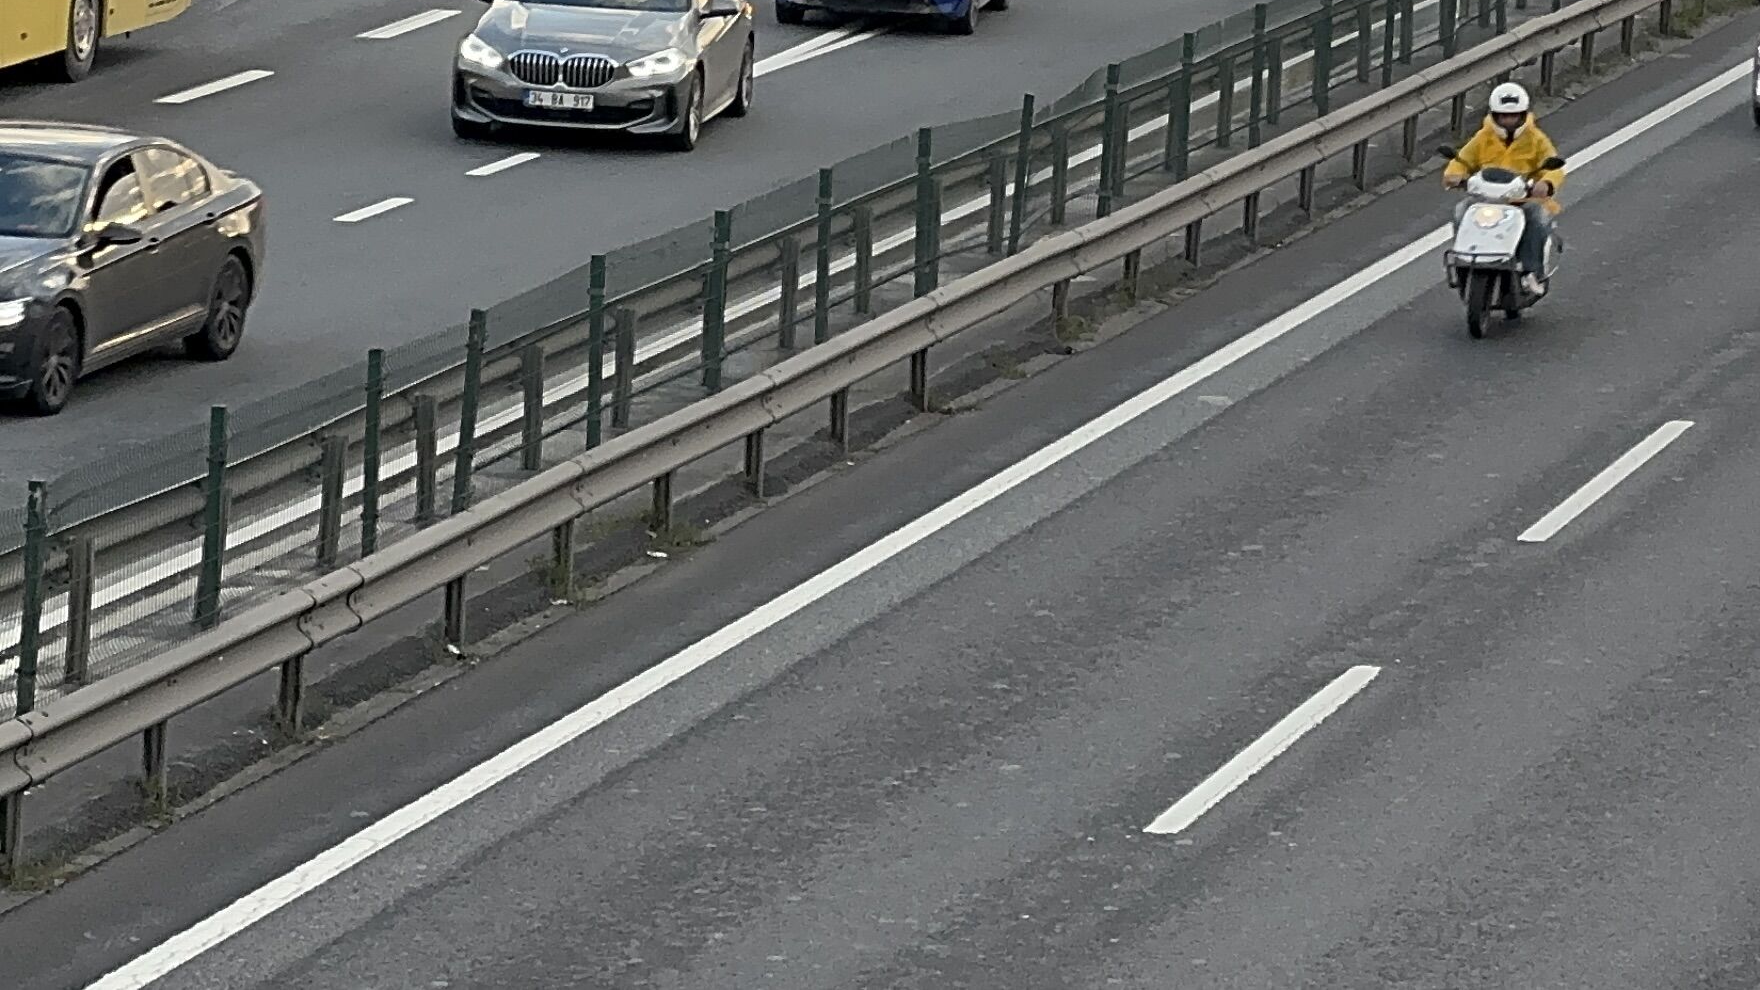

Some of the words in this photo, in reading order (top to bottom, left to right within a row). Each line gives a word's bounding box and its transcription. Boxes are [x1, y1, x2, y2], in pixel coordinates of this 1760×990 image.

[531, 92, 543, 104] 34
[552, 93, 564, 106] BA
[573, 95, 591, 108] 917
